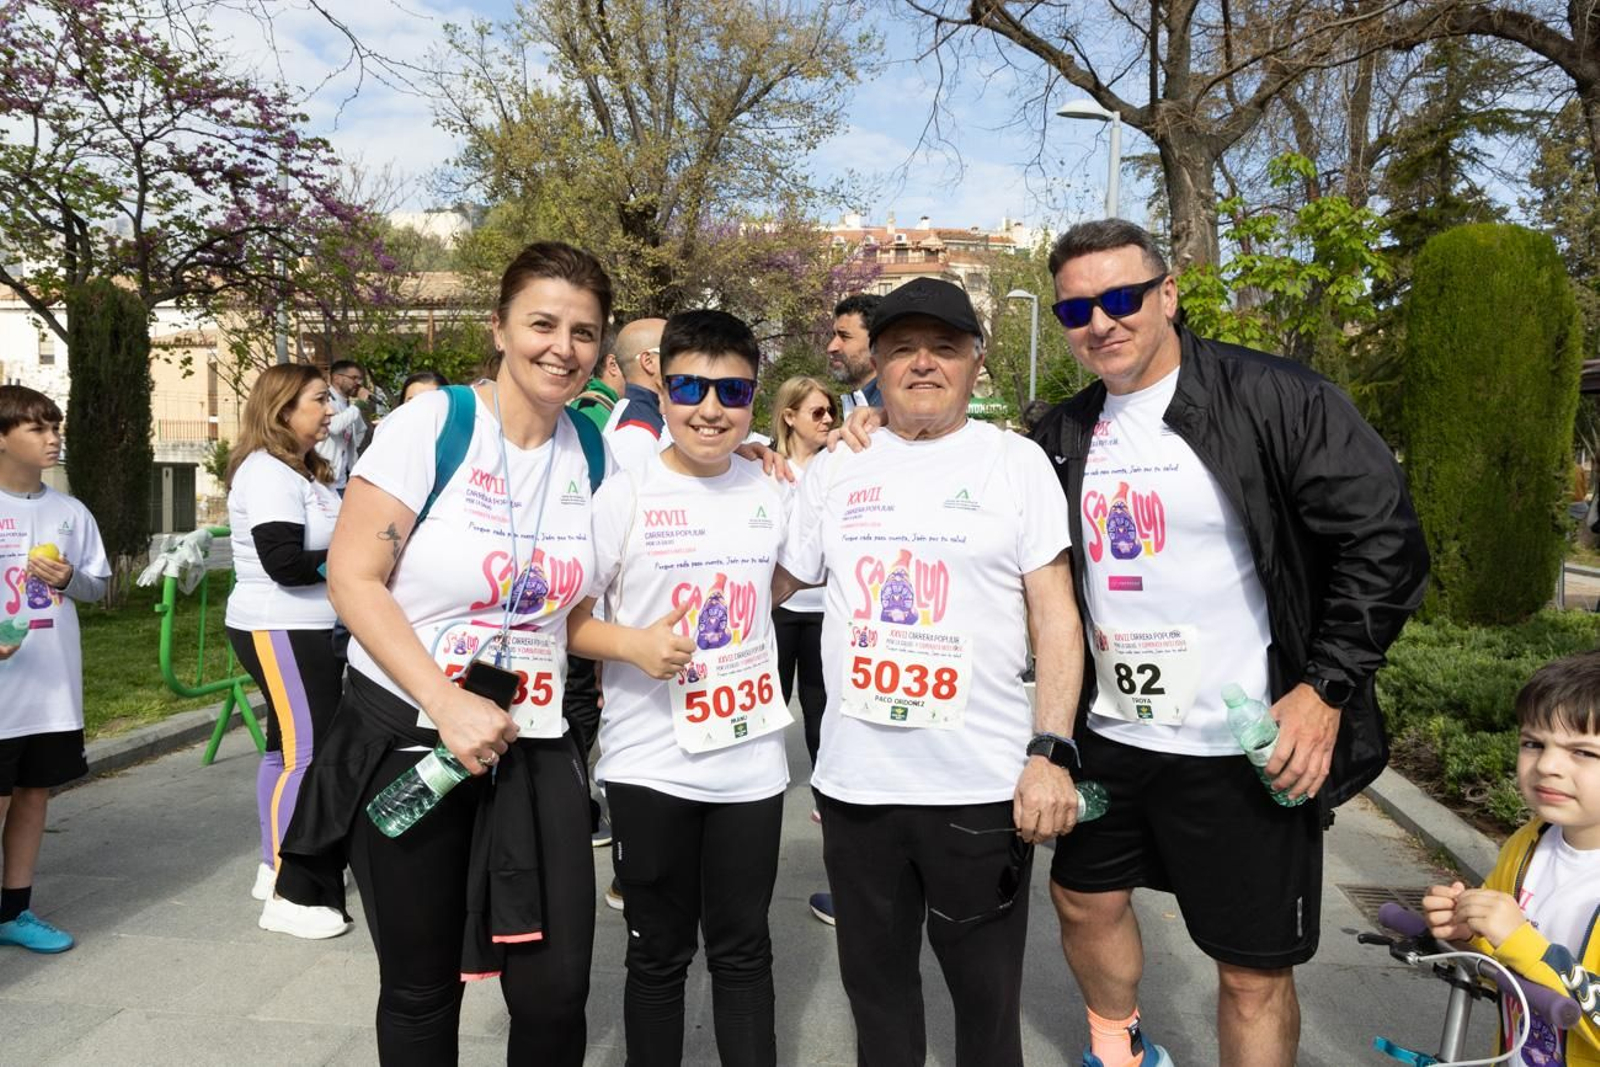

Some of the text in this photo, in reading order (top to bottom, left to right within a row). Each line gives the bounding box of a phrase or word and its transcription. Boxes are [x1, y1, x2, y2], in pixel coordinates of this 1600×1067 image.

[847, 486, 882, 507] XXVII
[644, 509, 689, 528] XXVII
[1083, 490, 1166, 563] SALUD
[645, 528, 706, 540] CARRERA POPULAR
[470, 549, 584, 611] SALUD
[853, 555, 949, 623] SALUD
[671, 580, 757, 641] SALUD
[908, 631, 933, 641] CARRERA
[1131, 632, 1154, 641] CARRERA
[851, 656, 959, 701] 5038
[1114, 662, 1166, 695] 82
[685, 672, 774, 723] 5036
[875, 694, 893, 704] PACO
[1132, 697, 1153, 705] TROYA
